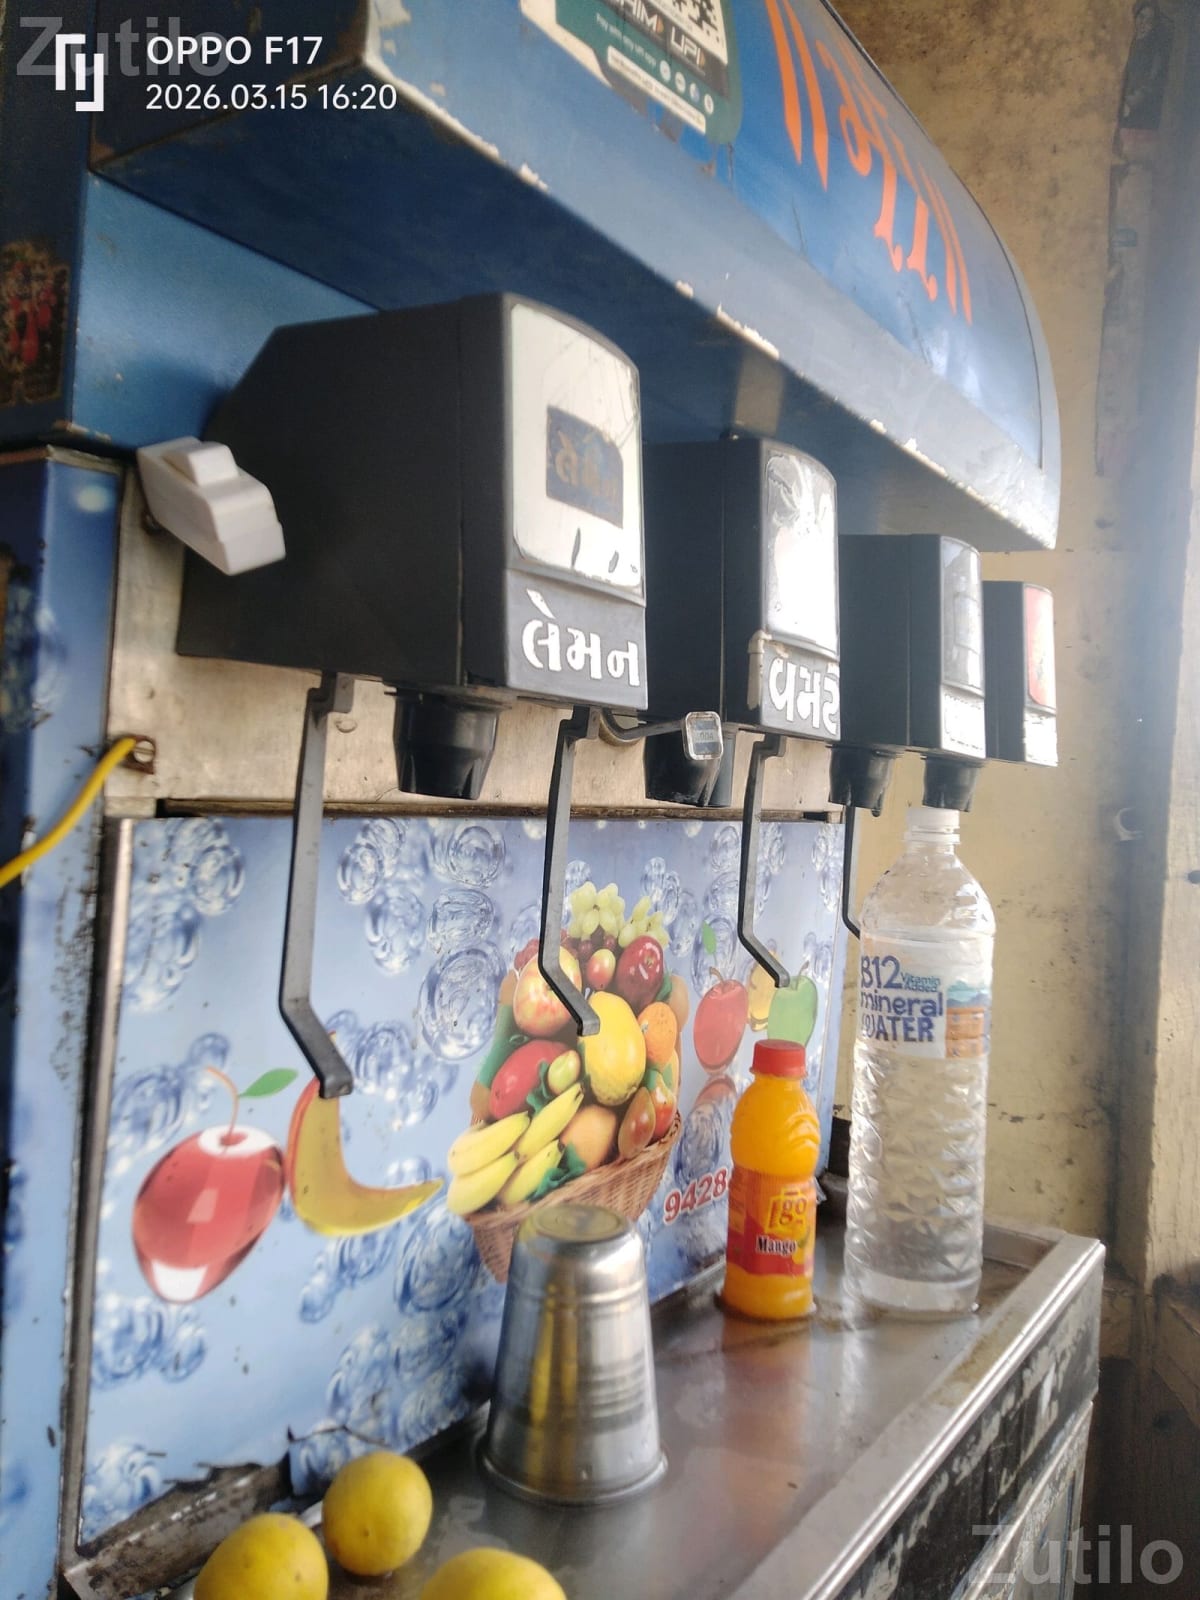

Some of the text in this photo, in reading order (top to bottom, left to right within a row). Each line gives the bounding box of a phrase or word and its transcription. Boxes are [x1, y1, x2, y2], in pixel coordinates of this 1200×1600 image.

[671, 26, 701, 66] UPI
[522, 588, 640, 687] લેમન
[861, 955, 902, 989] B12
[861, 989, 943, 1017] mineral
[756, 1234, 798, 1257] Mango
